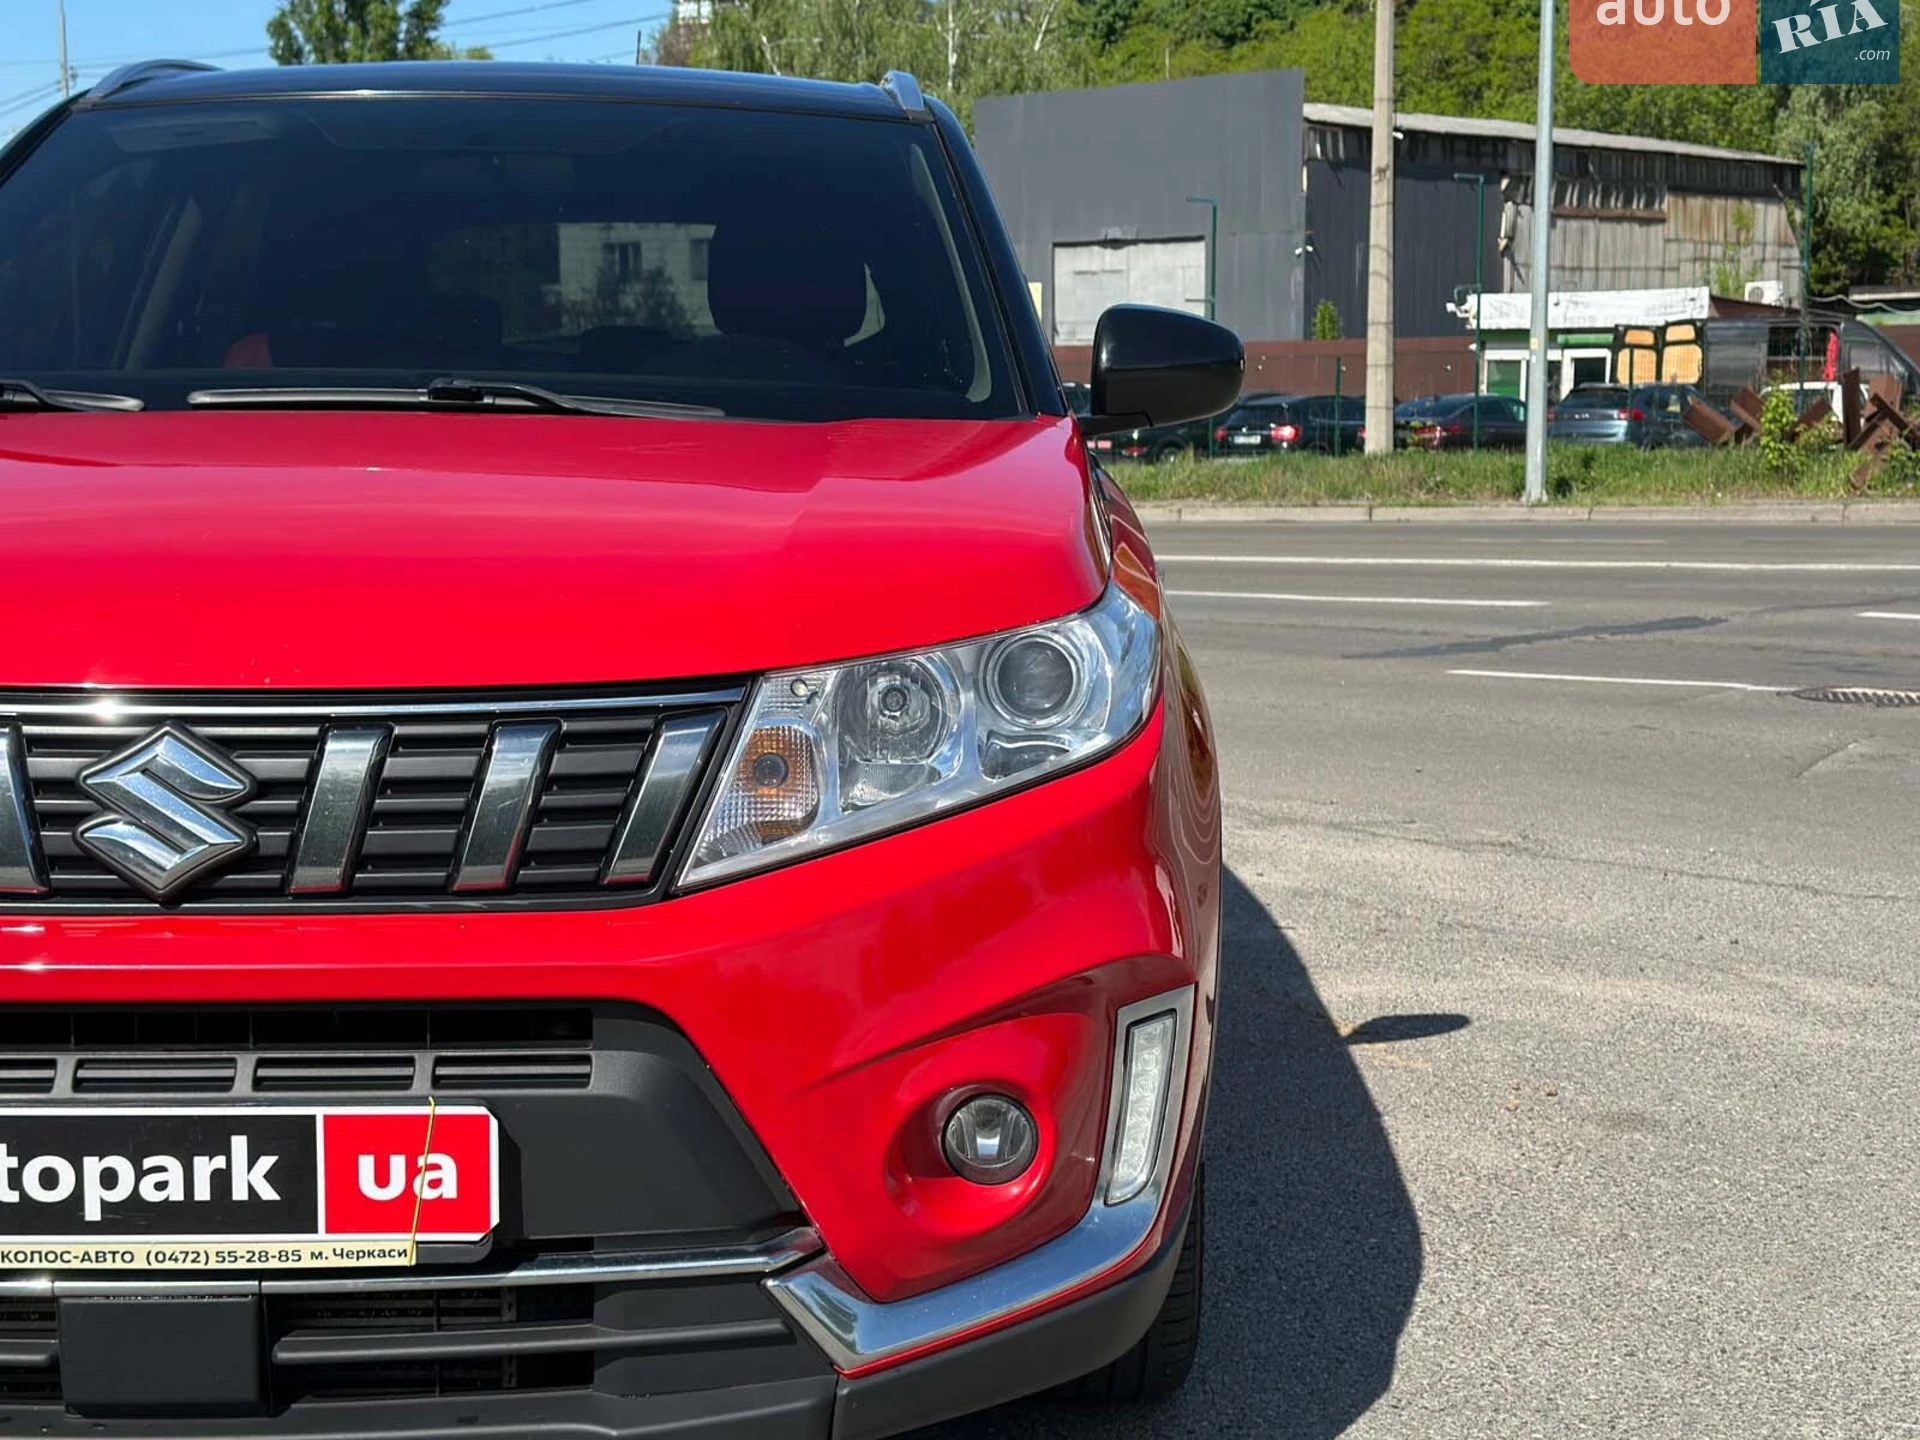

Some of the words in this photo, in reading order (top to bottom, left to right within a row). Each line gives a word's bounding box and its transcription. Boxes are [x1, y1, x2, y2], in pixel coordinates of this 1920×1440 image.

[357, 1153, 458, 1200] ua
[0, 1249, 135, 1264] КОЛОС-АВТО
[145, 1249, 209, 1266] (0472)
[215, 1249, 302, 1264] 55-28-85
[310, 1251, 328, 1261] м.
[332, 1247, 408, 1261] Черкаси
